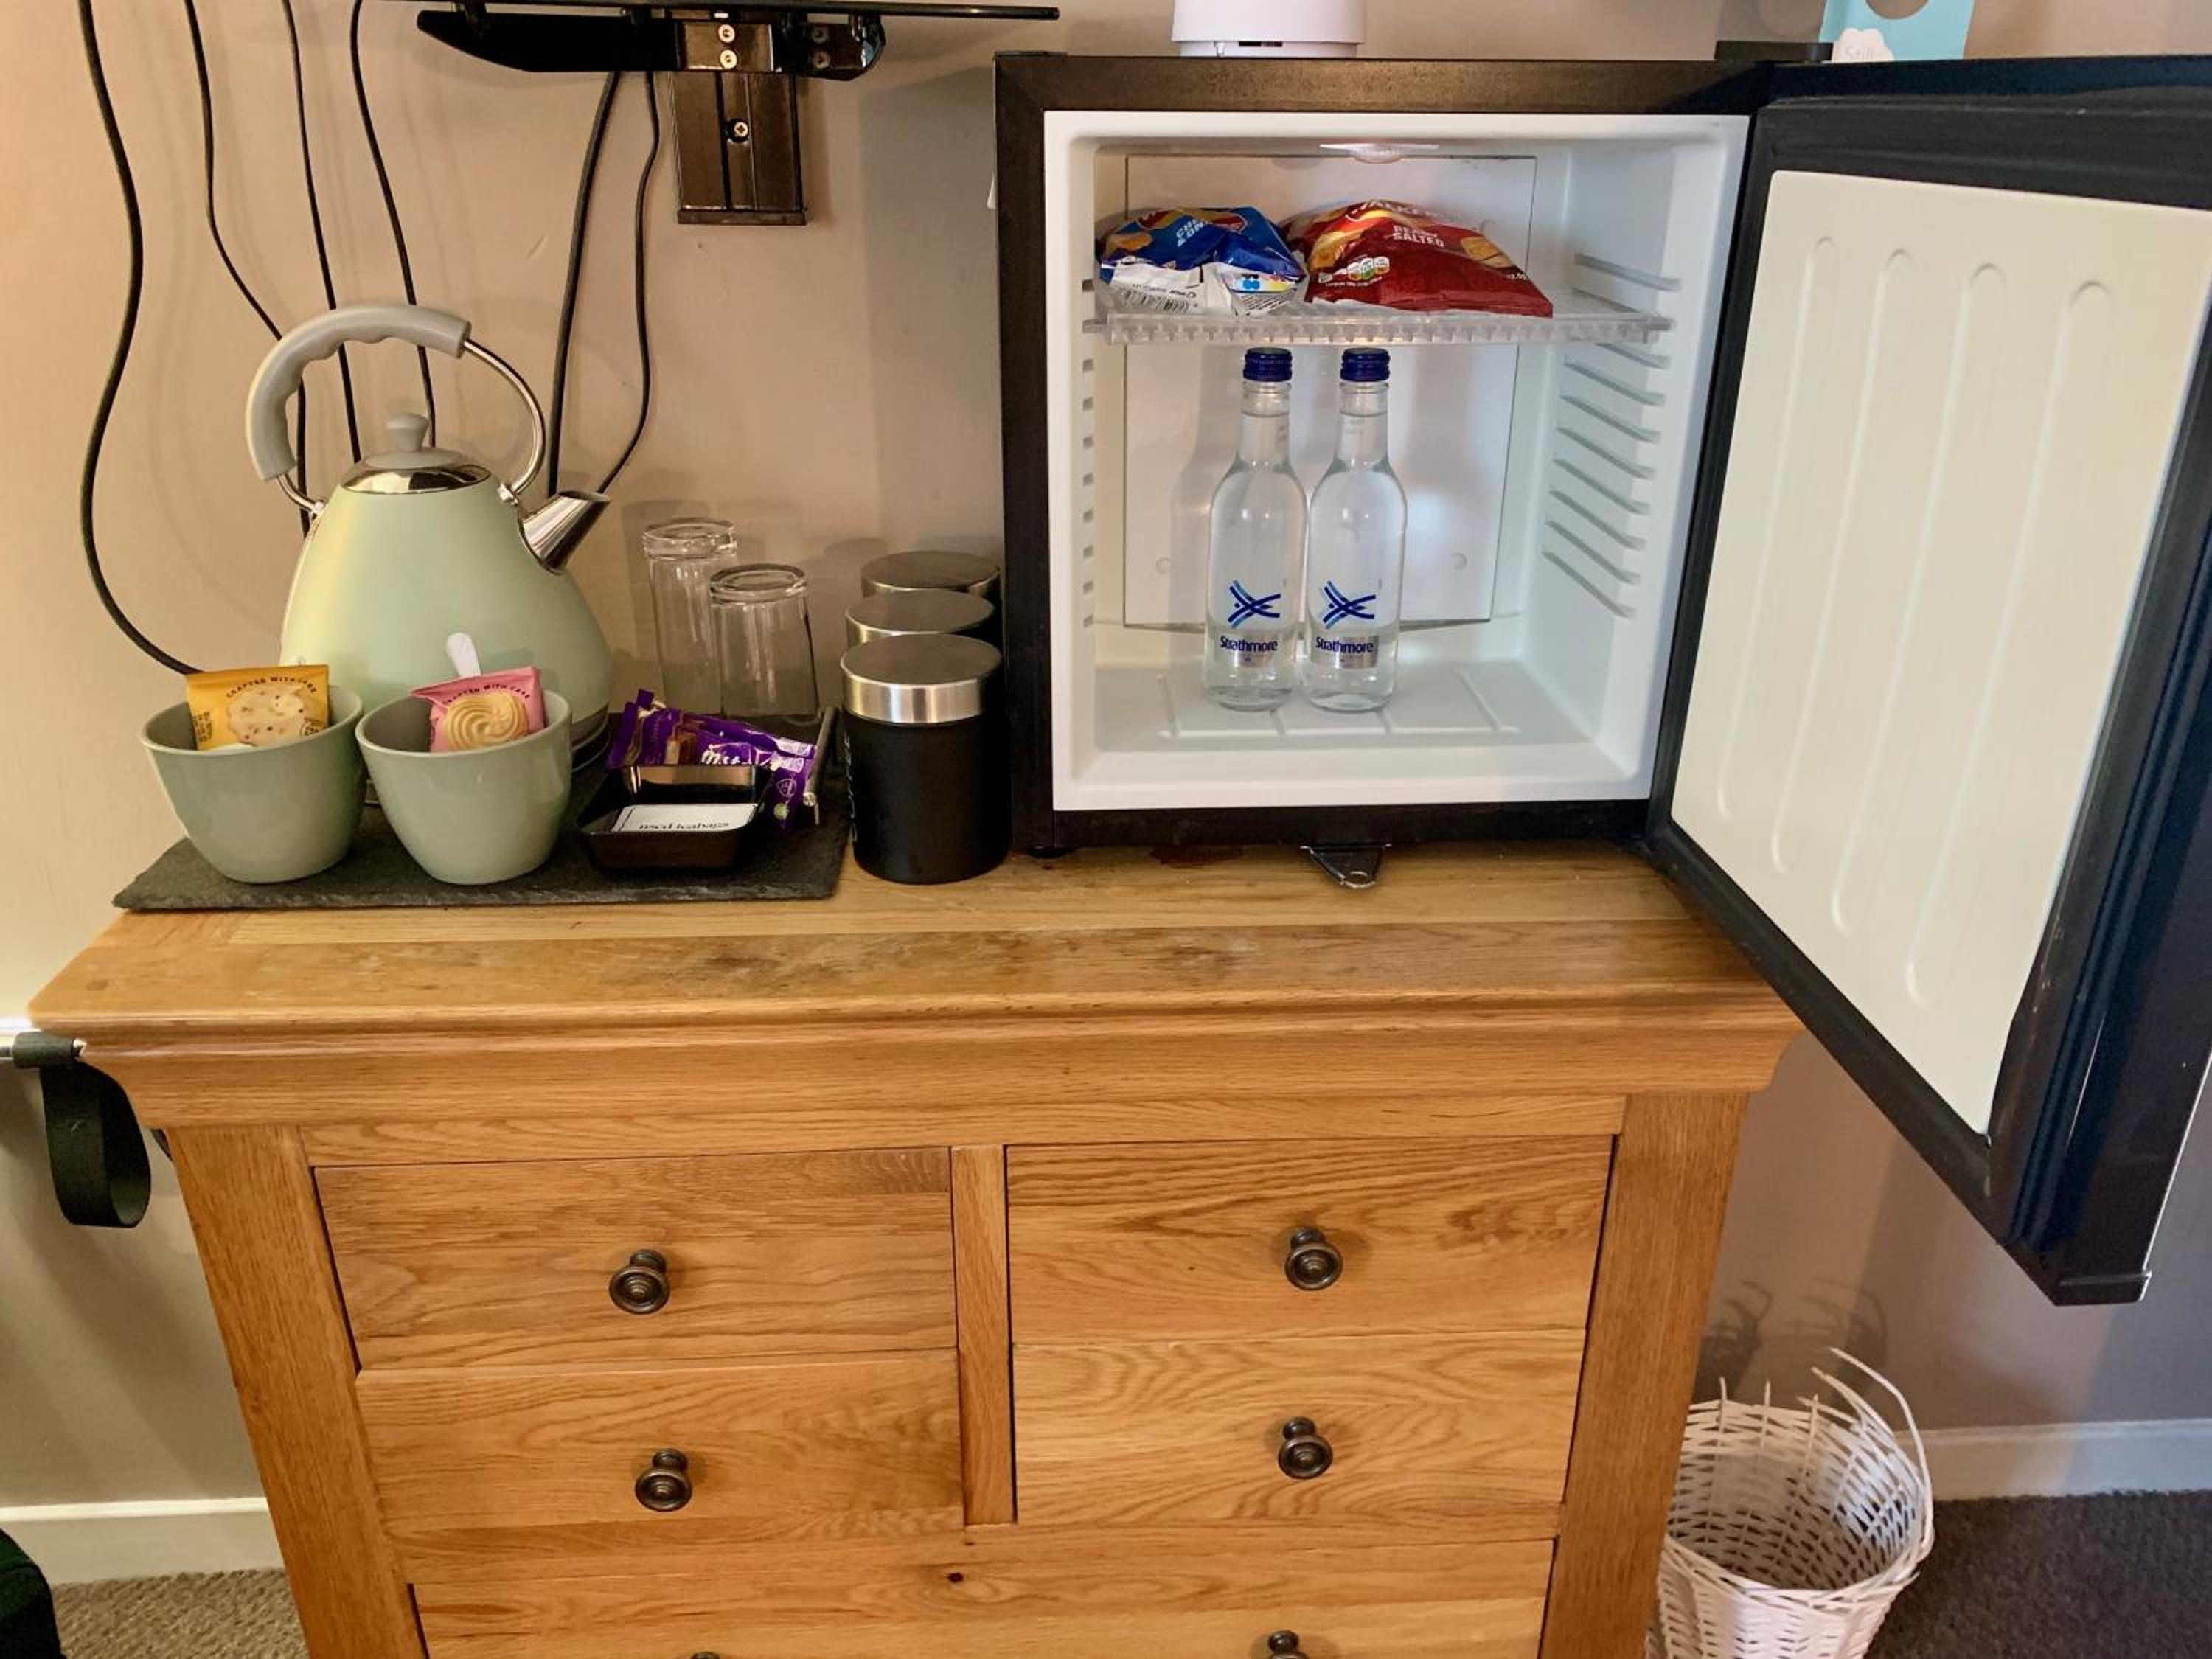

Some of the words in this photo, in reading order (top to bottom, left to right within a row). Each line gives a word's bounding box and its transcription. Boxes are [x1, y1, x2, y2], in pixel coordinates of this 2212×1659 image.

[1392, 232, 1444, 248] SALTED
[1220, 635, 1279, 652] Strathmore
[1315, 636, 1374, 653] Strathmore
